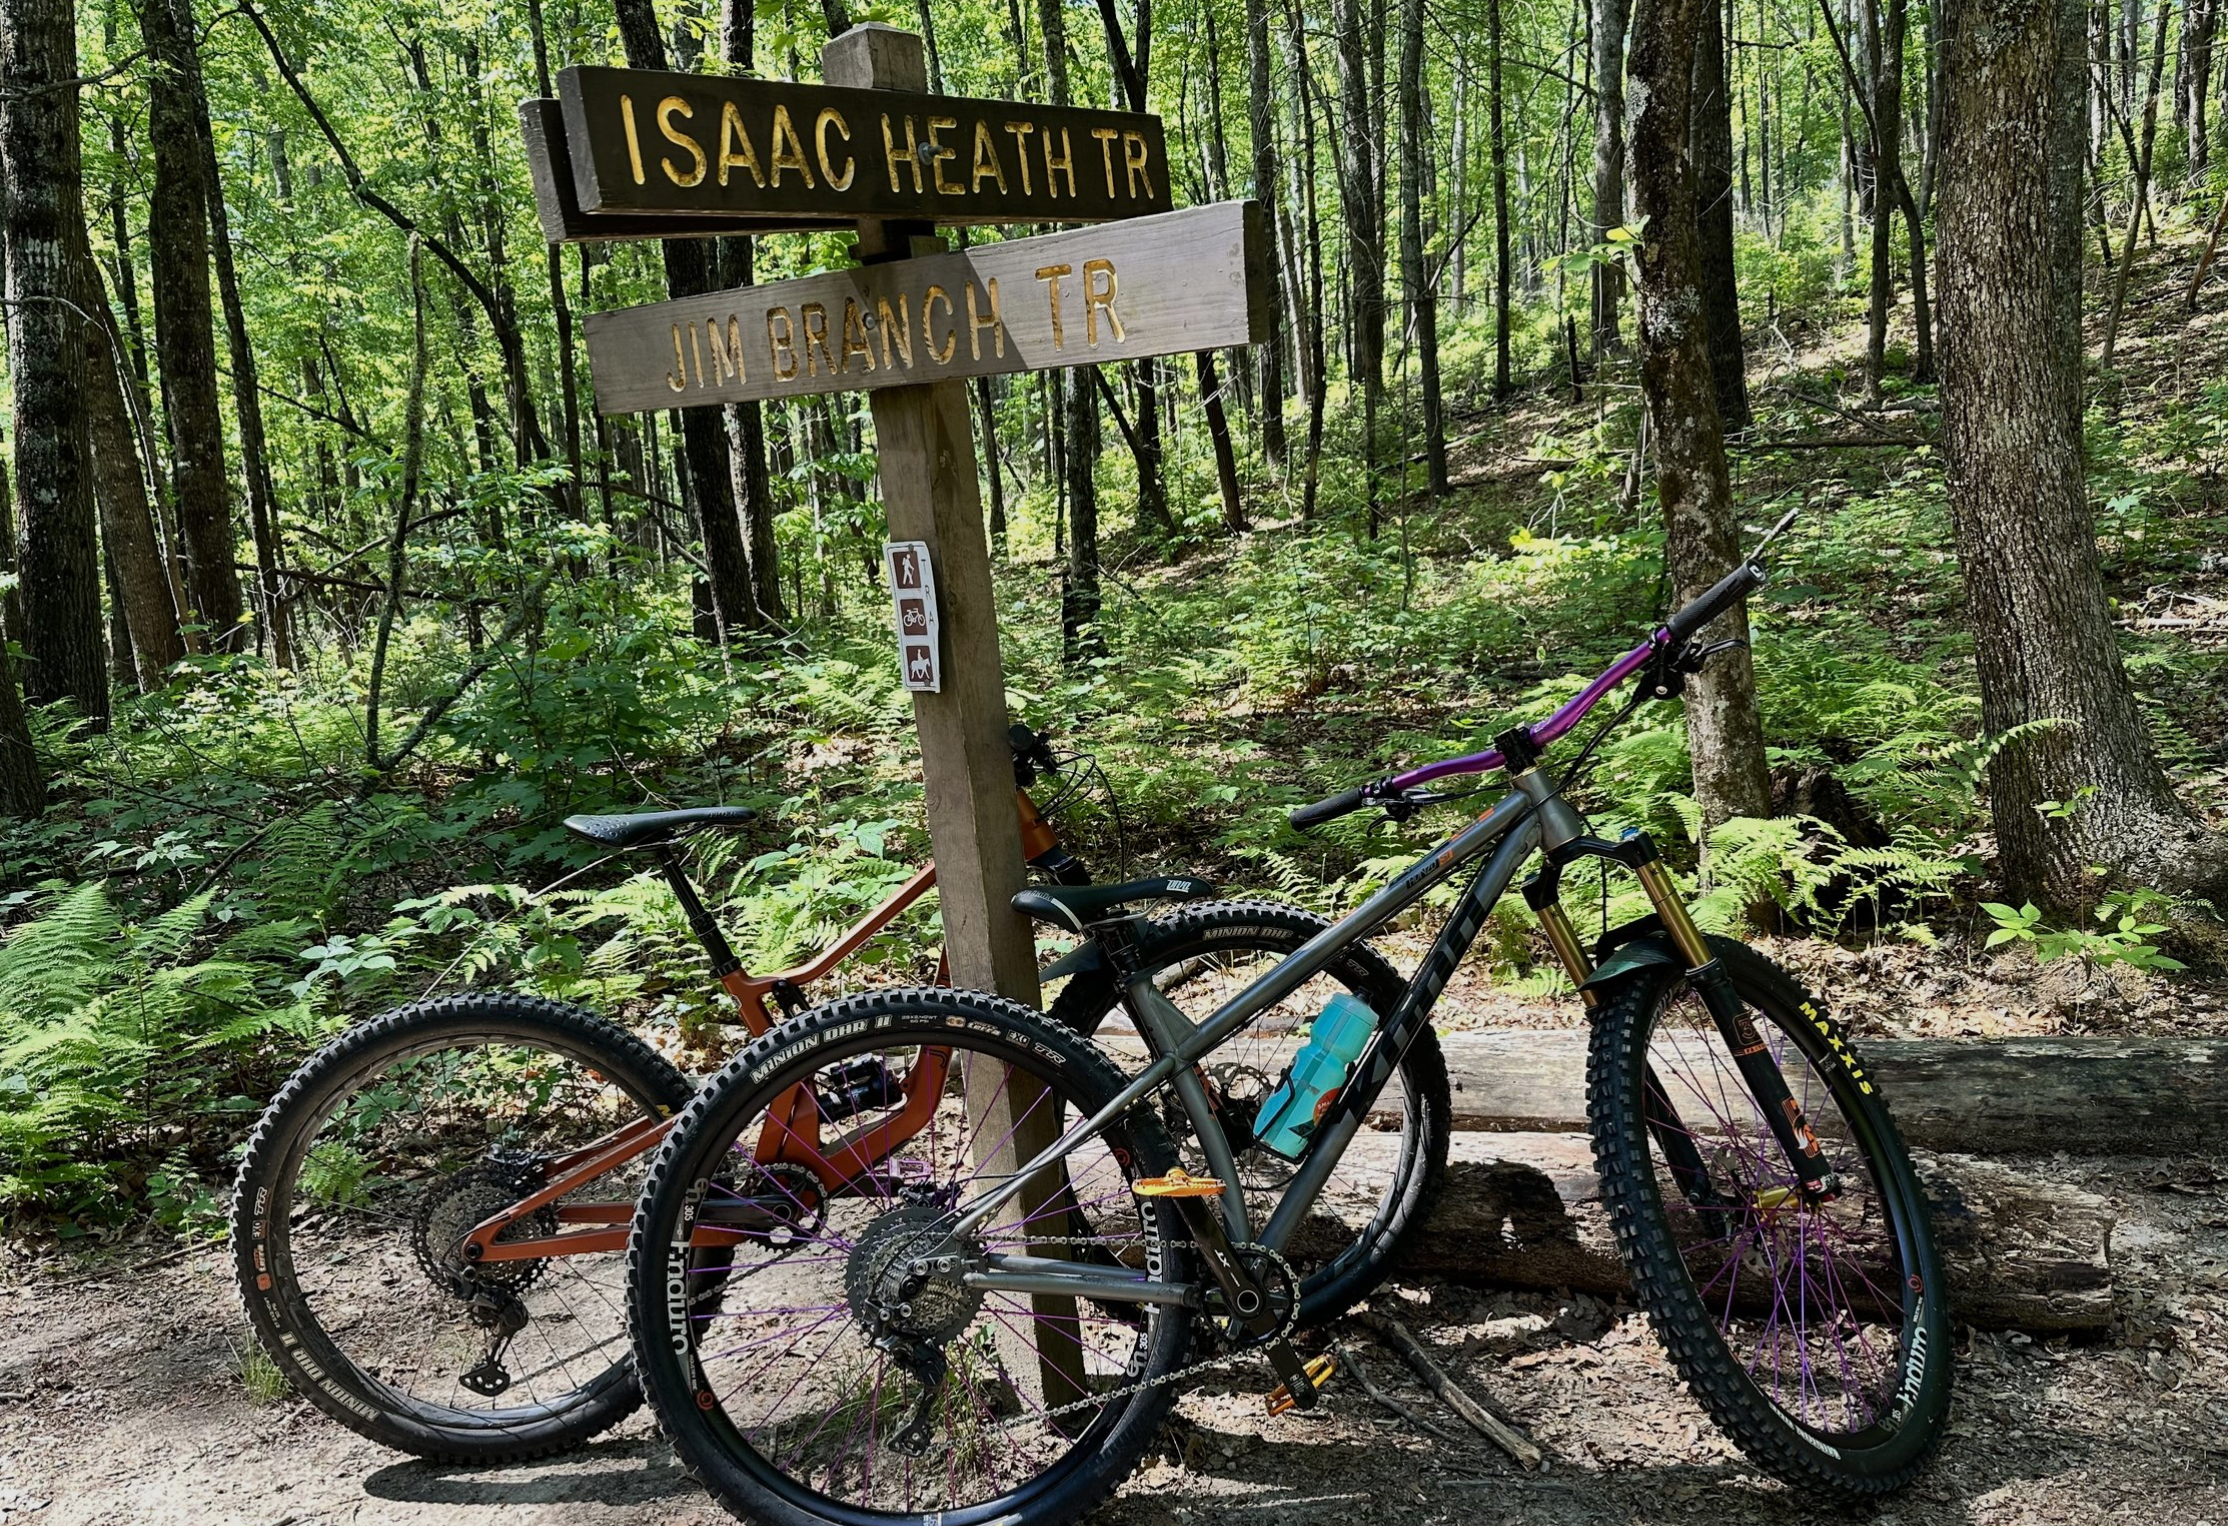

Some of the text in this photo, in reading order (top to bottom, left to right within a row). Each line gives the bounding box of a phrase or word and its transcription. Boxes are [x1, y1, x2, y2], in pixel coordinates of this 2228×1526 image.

[620, 94, 1154, 200] ISAAC HEATH TR
[665, 258, 1126, 393] JIM BRANCH TR
[1202, 926, 1260, 940] MINION
[751, 1033, 820, 1084] MINION
[823, 1018, 869, 1043] DHR
[1007, 1030, 1030, 1047] EXO
[1034, 1041, 1067, 1065] TR
[1798, 1001, 1873, 1095] MAXXIS
[684, 1204, 694, 1222] 305
[666, 1240, 690, 1356] Enduro
[1138, 1331, 1149, 1350] 305
[290, 1347, 325, 1382] DHR
[1895, 1326, 1928, 1408] Enduro
[317, 1376, 381, 1423] MINION
